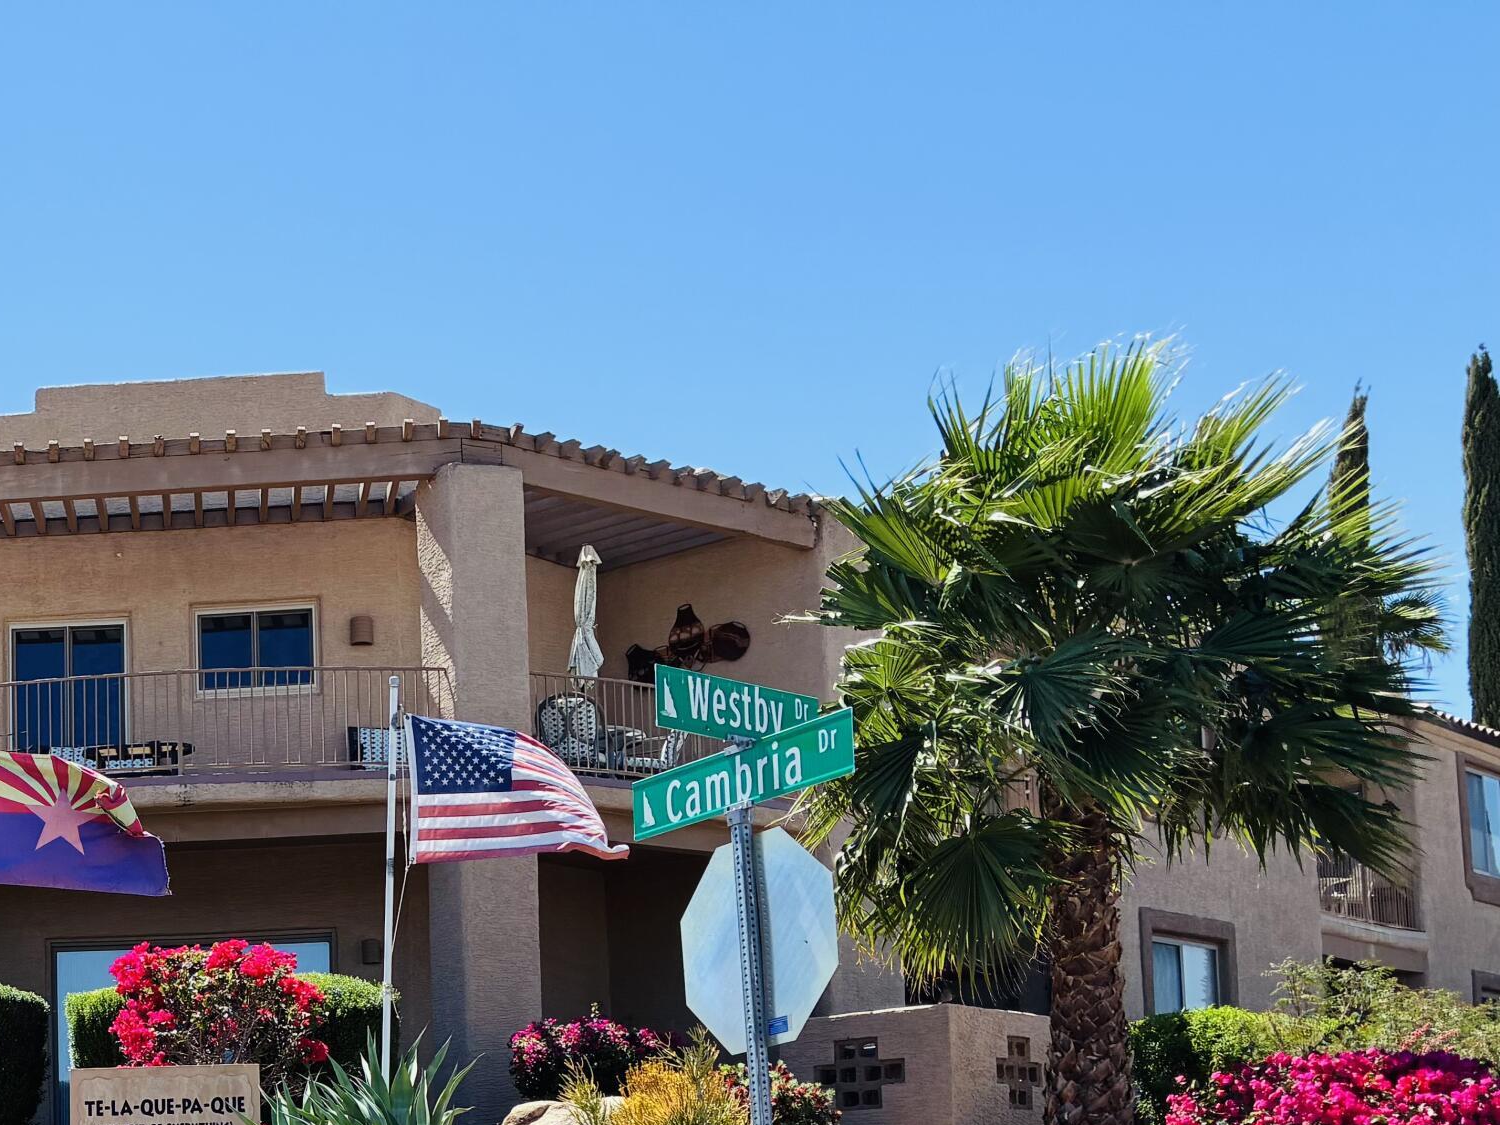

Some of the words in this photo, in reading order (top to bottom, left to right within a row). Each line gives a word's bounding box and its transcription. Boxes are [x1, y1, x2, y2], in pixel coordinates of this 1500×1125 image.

[687, 675, 783, 734] Westby
[795, 698, 809, 721] Dr
[666, 741, 803, 823] Cambria
[818, 728, 837, 753] Dr
[85, 1097, 246, 1117] TE-LA-QUE-PA-QUE
